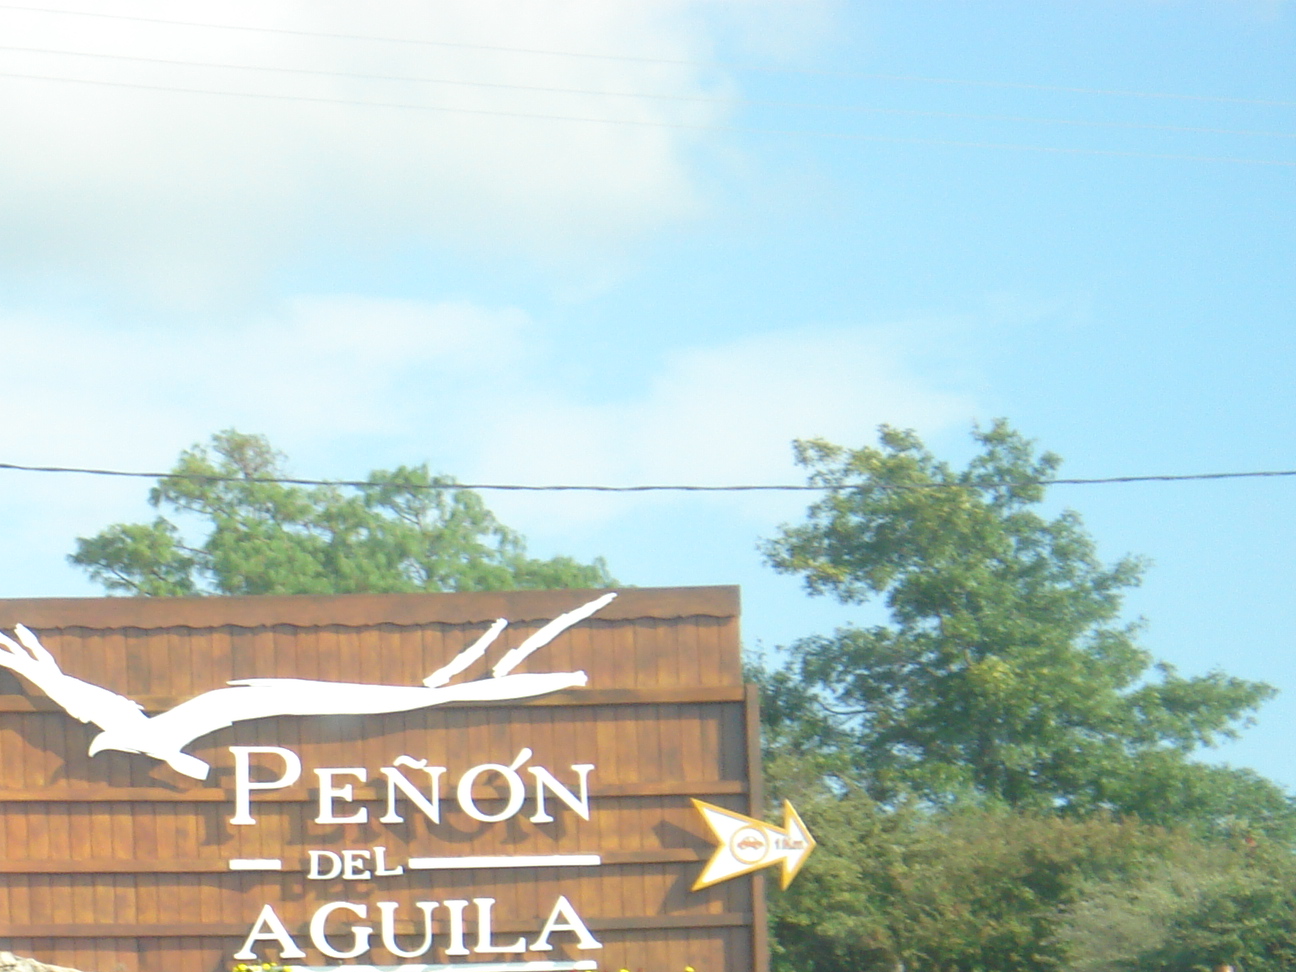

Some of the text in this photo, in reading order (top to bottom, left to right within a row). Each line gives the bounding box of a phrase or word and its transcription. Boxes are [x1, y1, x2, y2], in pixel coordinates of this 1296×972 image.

[229, 746, 594, 826] PEÑÓN
[307, 846, 403, 880] DEL
[233, 895, 603, 960] AGUILA
